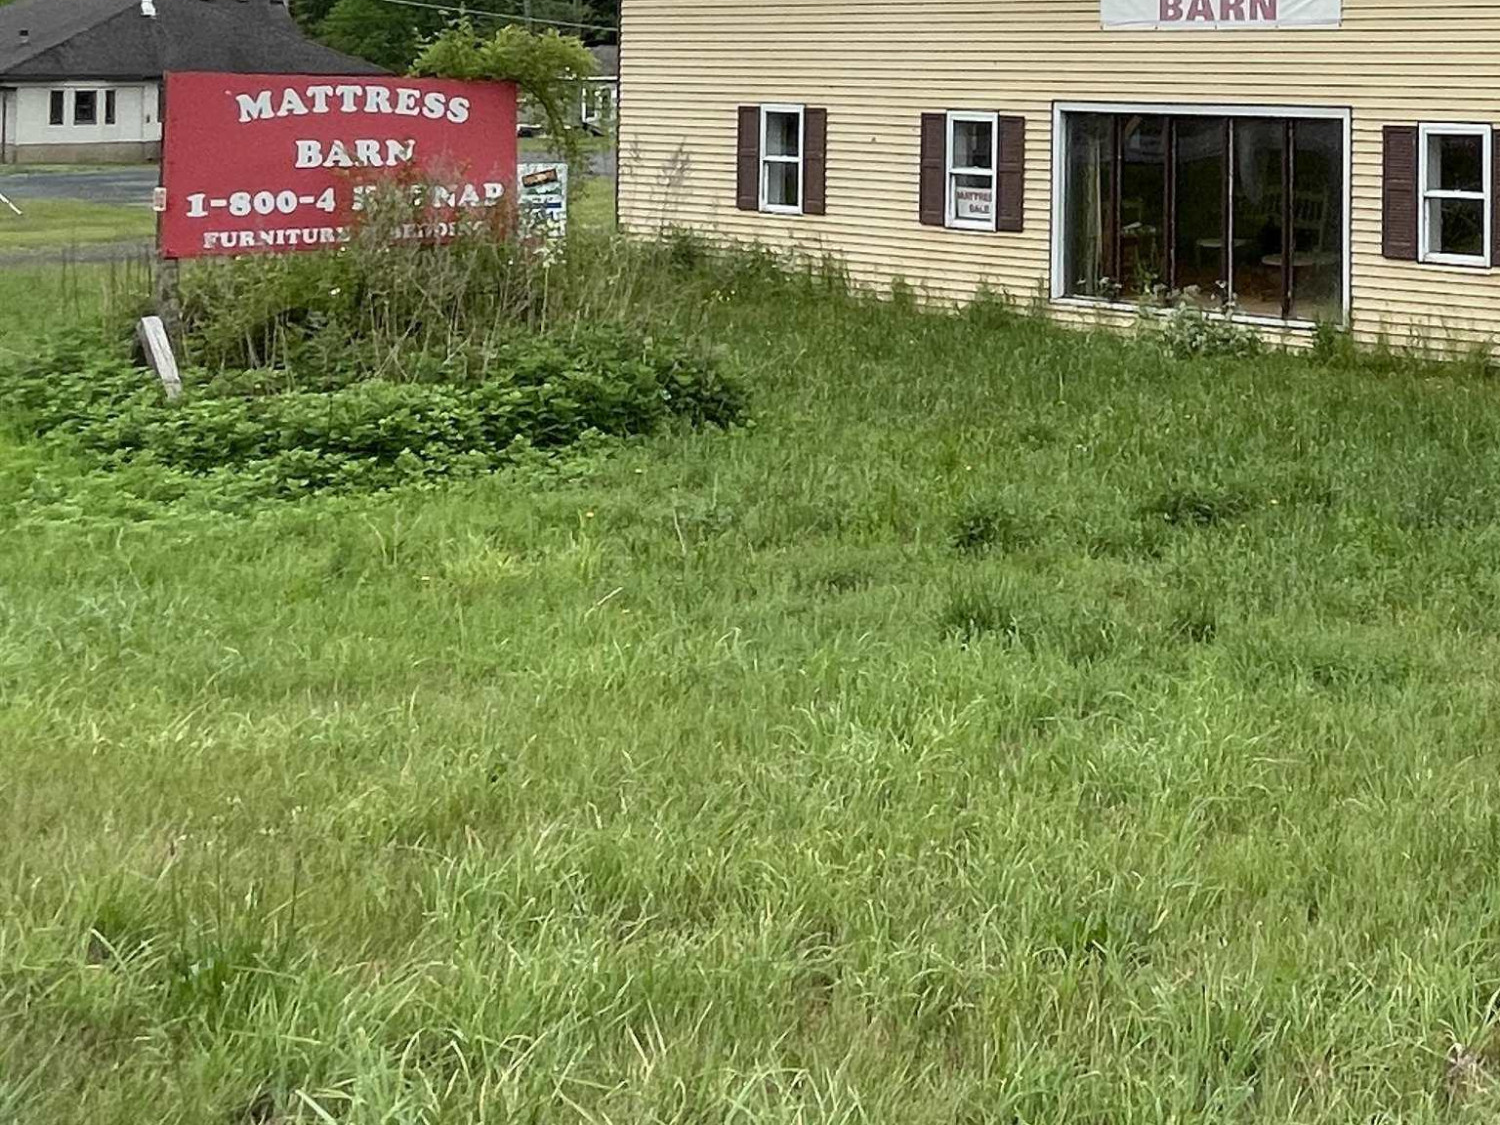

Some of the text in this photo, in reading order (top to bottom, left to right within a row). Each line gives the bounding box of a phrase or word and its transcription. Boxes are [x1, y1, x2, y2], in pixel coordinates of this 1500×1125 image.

[235, 84, 471, 124] MATTRESS
[294, 138, 416, 169] BARN
[185, 186, 337, 218] 1-800-4
